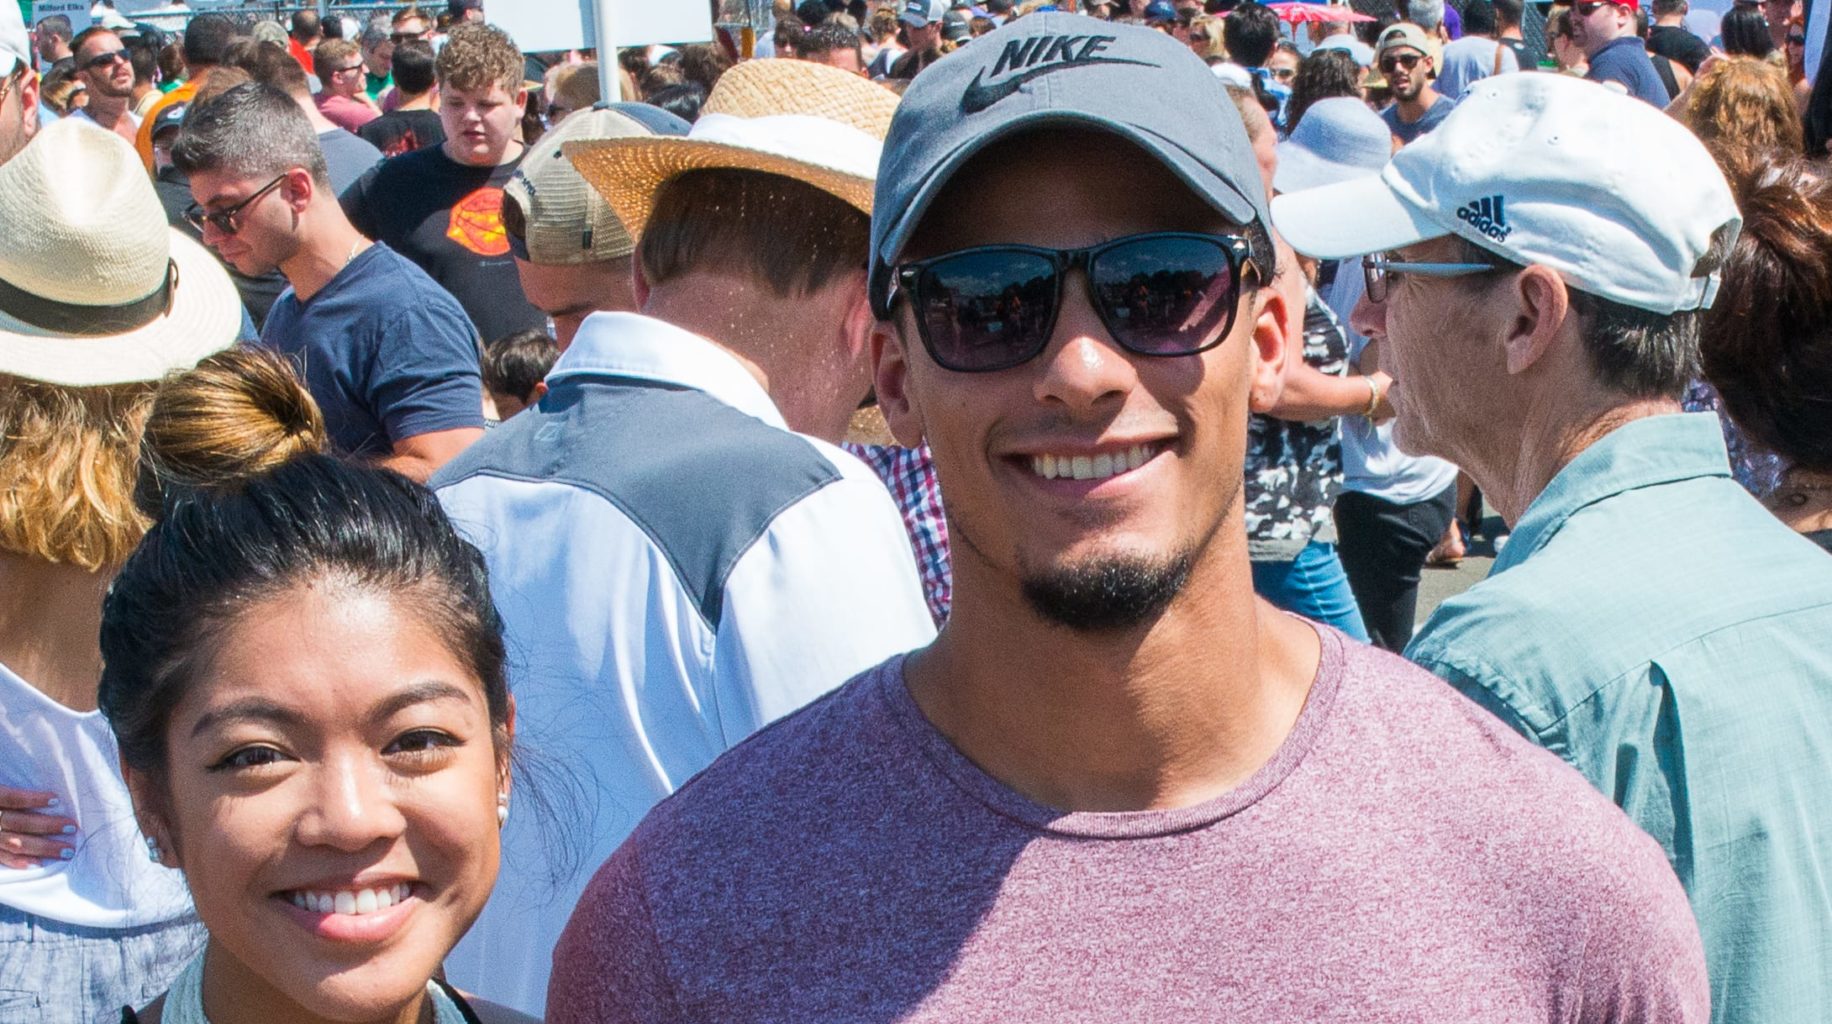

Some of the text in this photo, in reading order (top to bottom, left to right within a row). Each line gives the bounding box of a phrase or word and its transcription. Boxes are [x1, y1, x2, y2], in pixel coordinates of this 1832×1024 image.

[38, 3, 84, 12] Milford Elks
[990, 35, 1117, 78] NIKE
[1457, 206, 1506, 243] adidas
